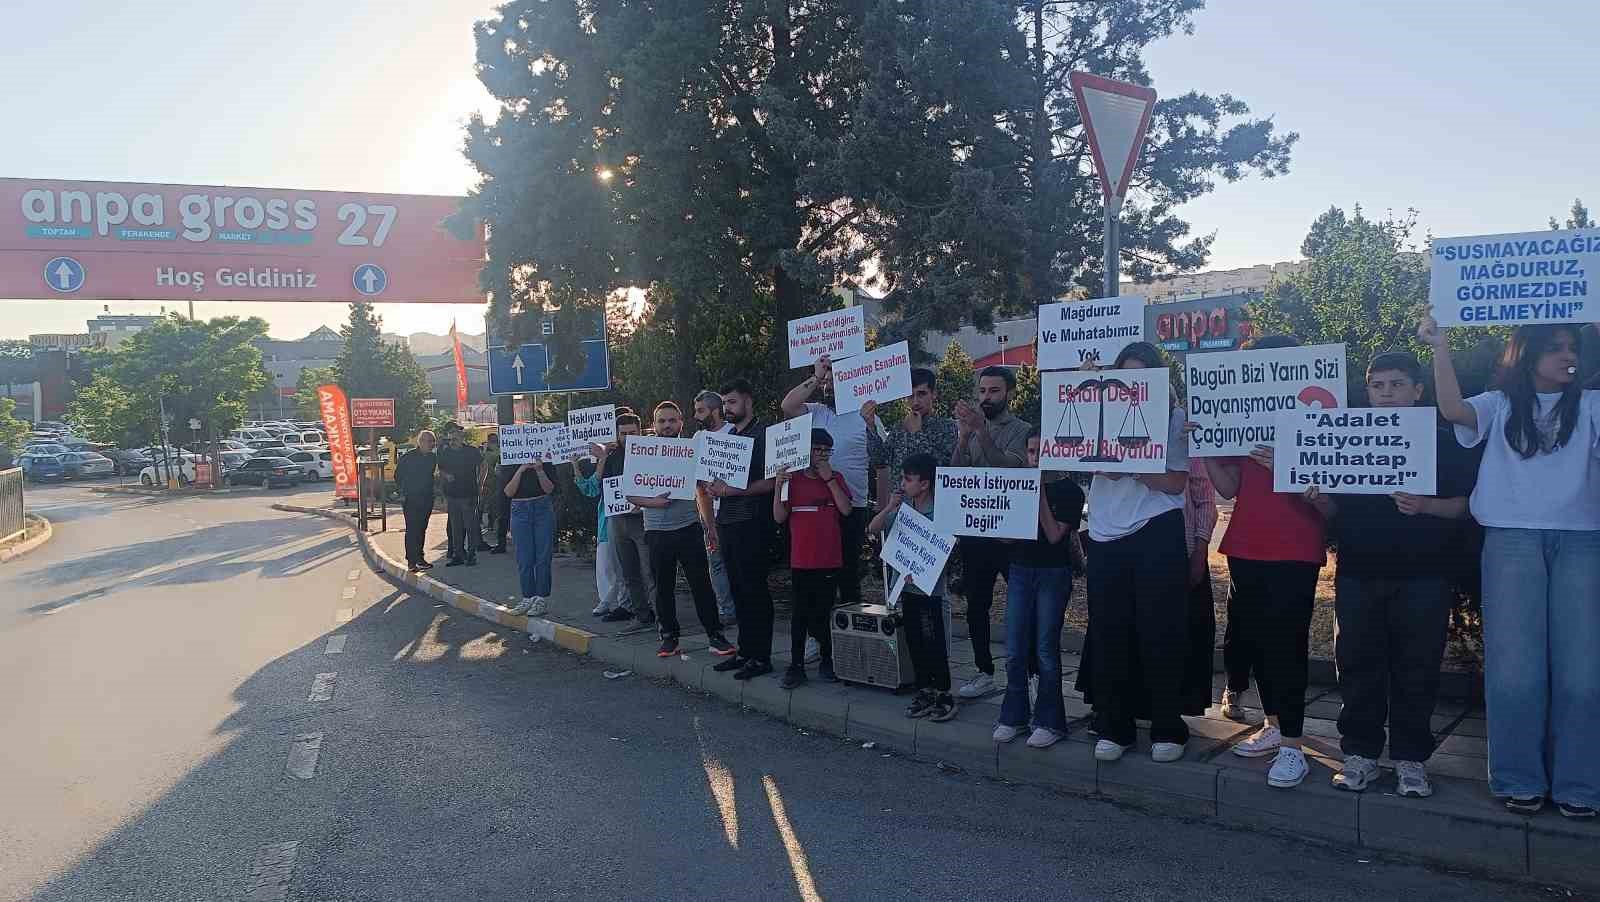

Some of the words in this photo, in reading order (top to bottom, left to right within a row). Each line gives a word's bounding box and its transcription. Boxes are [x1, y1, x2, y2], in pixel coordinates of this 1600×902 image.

[22, 190, 164, 236] anpa
[179, 194, 318, 242] gross
[337, 203, 397, 247] 27
[155, 267, 204, 289] Hoş
[215, 267, 318, 289] Geldiniz
[1460, 259, 1585, 281] MAĞDURUZ,
[1456, 280, 1588, 301] GÖRMEZDEN
[1060, 304, 1121, 322] Mağduruz
[1042, 330, 1057, 343] Ve
[1060, 325, 1140, 343] Muhatabımız
[828, 341, 844, 353] AVM
[1190, 364, 1236, 390] Bugün
[1242, 362, 1265, 384] Bizi
[1270, 361, 1309, 382] Yarın
[1314, 358, 1339, 380] Sizi
[604, 411, 613, 421] ve
[1305, 412, 1400, 428] "Adalet
[1296, 430, 1411, 449] İstiyoruz,
[631, 443, 658, 456] Esnaf
[661, 444, 694, 458] Birlikte
[1299, 451, 1407, 469] Muhatap
[633, 473, 686, 489] Güçlüdür!
[984, 472, 1038, 493] İstiyoruz,
[1290, 467, 1418, 488] İstiyoruz!"
[960, 494, 1011, 510] Sessizlik
